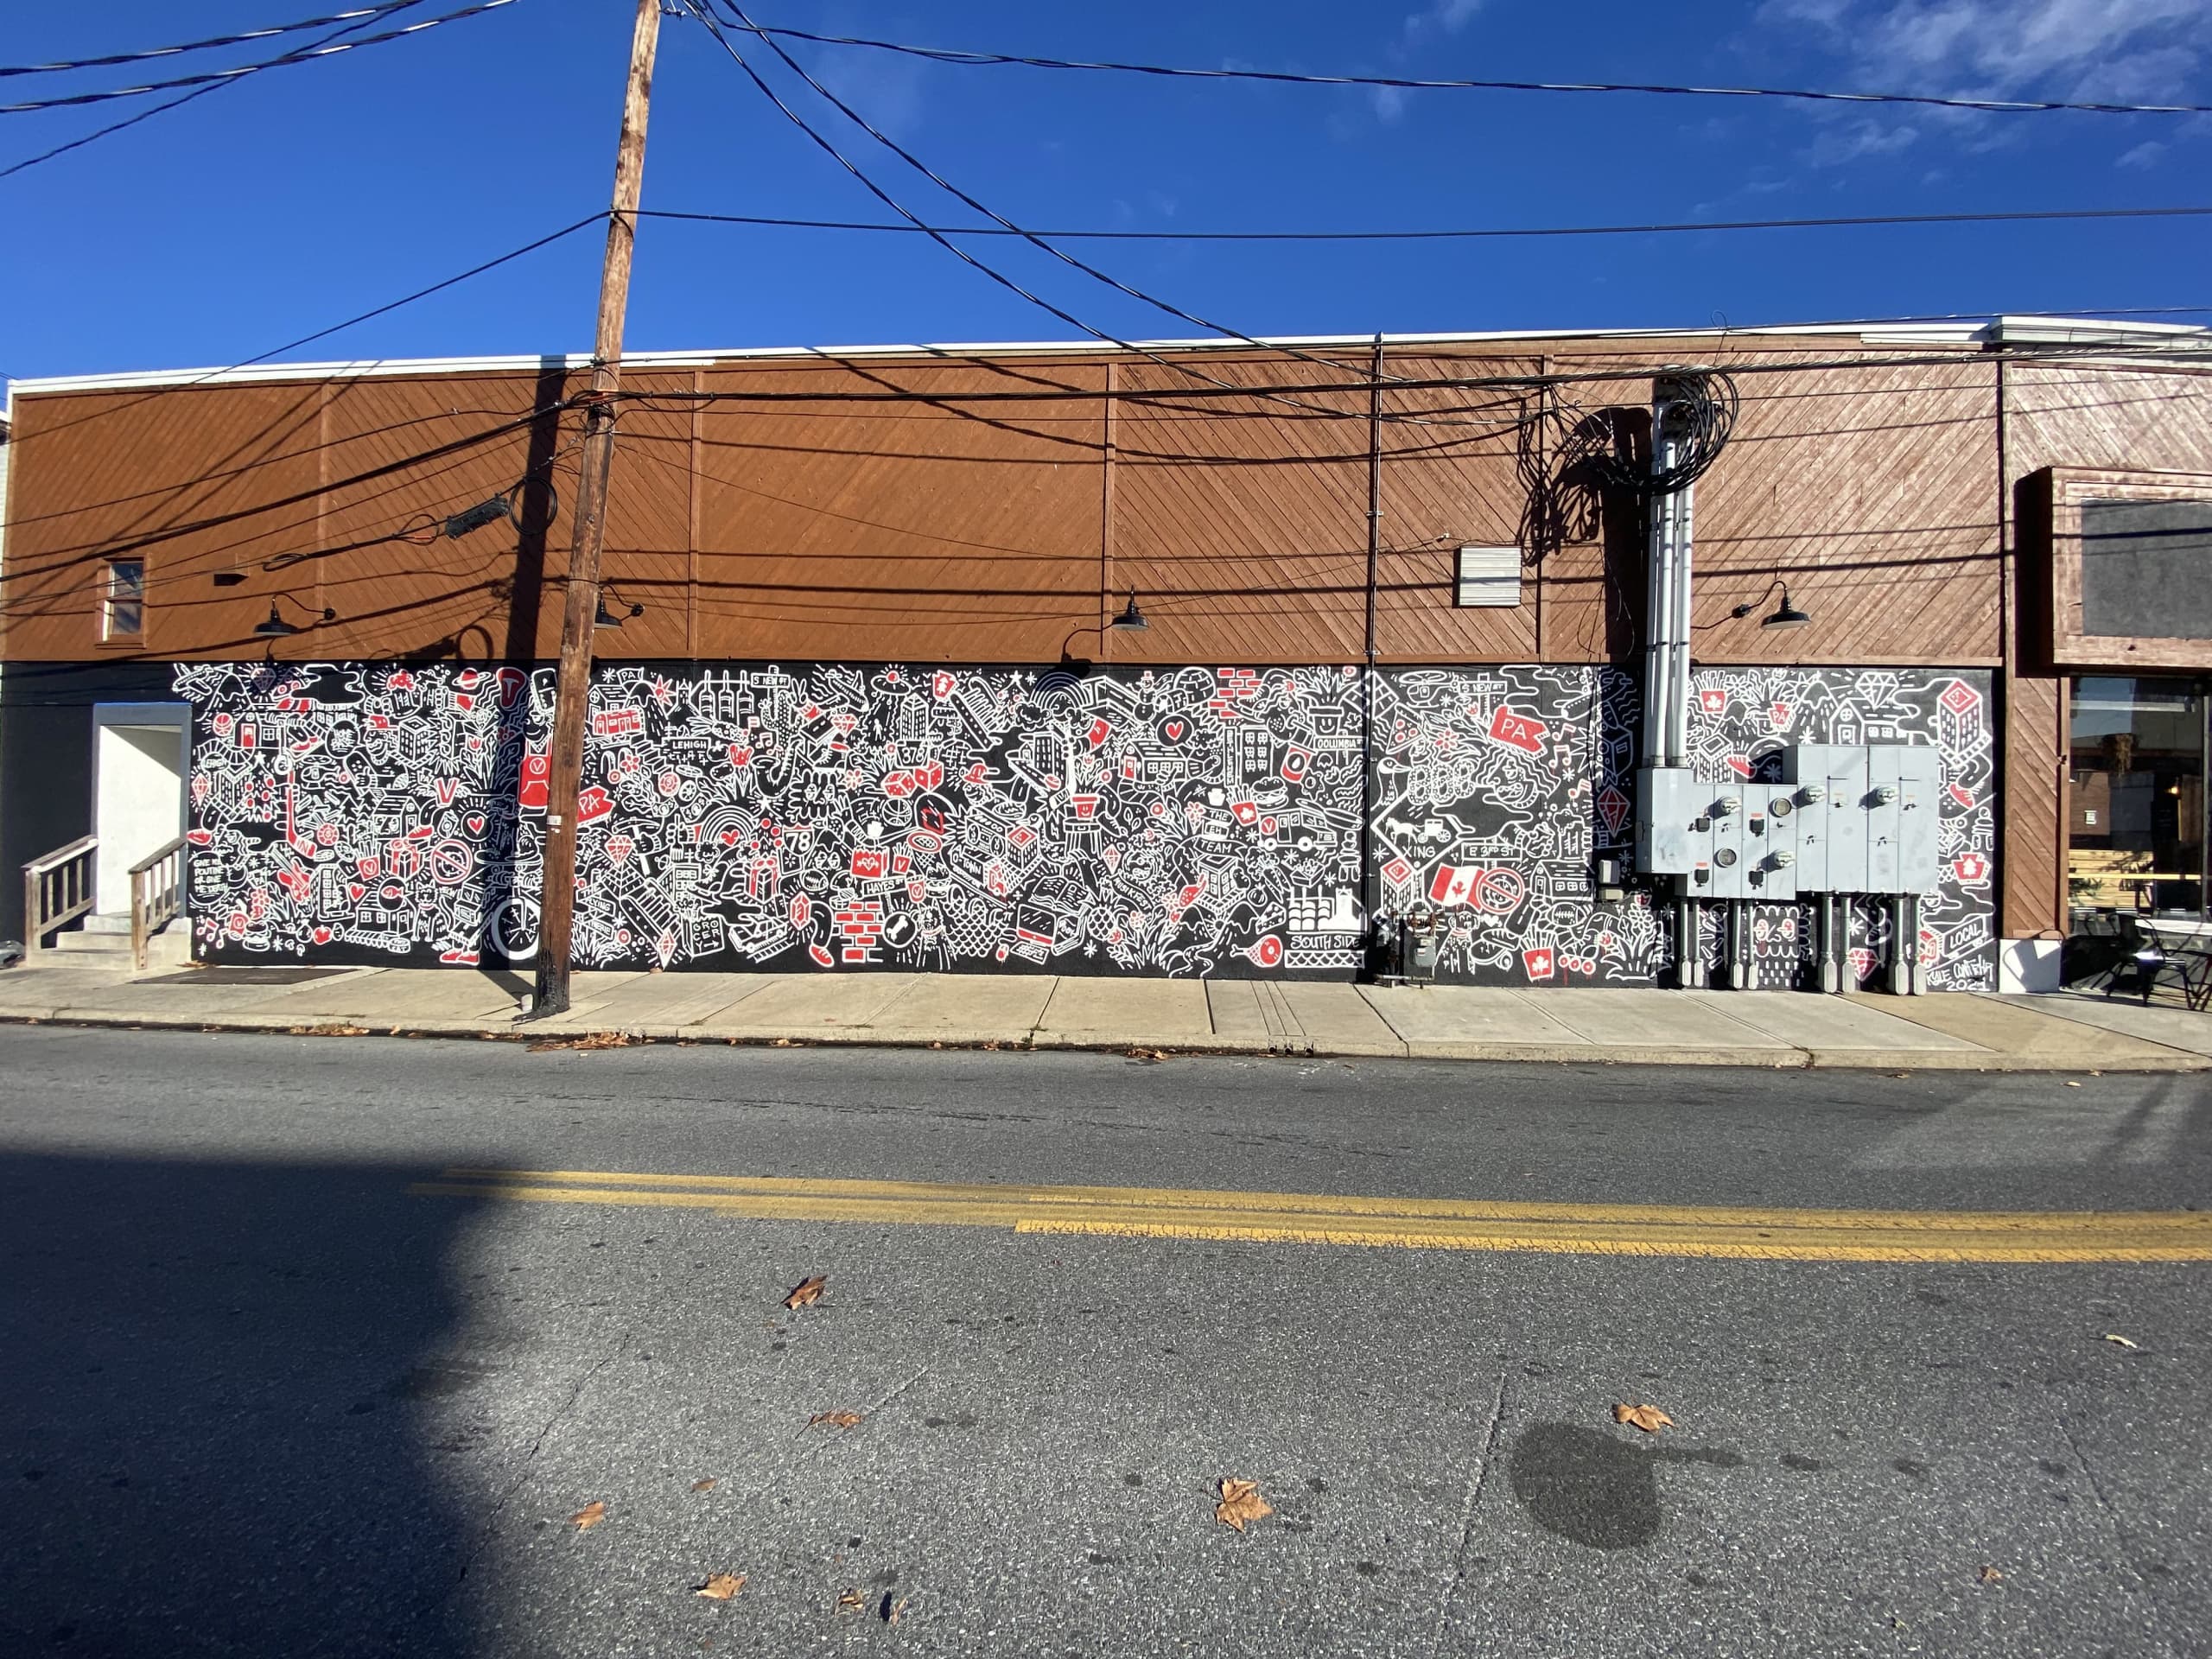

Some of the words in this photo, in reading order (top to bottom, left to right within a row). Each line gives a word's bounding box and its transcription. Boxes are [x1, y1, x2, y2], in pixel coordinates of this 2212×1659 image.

[621, 671, 635, 680] PA
[753, 676, 760, 685] S
[1461, 682, 1470, 692] S
[1472, 682, 1492, 692] NEW
[1771, 711, 1786, 725] PA
[1501, 717, 1528, 741] PA
[672, 740, 707, 750] LEHIGH
[1317, 738, 1356, 749] COLUMBIA
[901, 746, 925, 765] 378
[579, 794, 601, 813] PA
[1209, 809, 1229, 821] THE
[1209, 825, 1223, 835] EH
[785, 832, 806, 851] 78
[1199, 841, 1232, 854] TEAM
[1402, 846, 1436, 859] XING
[1469, 847, 1477, 856] E
[866, 881, 895, 894] HAYES
[1113, 876, 1150, 908] MUSIKFEST
[1290, 934, 1332, 950] SOUTH
[1333, 936, 1360, 949] SIDE
[1949, 923, 1982, 950] LOCAL
[1946, 976, 1991, 992] 2021
